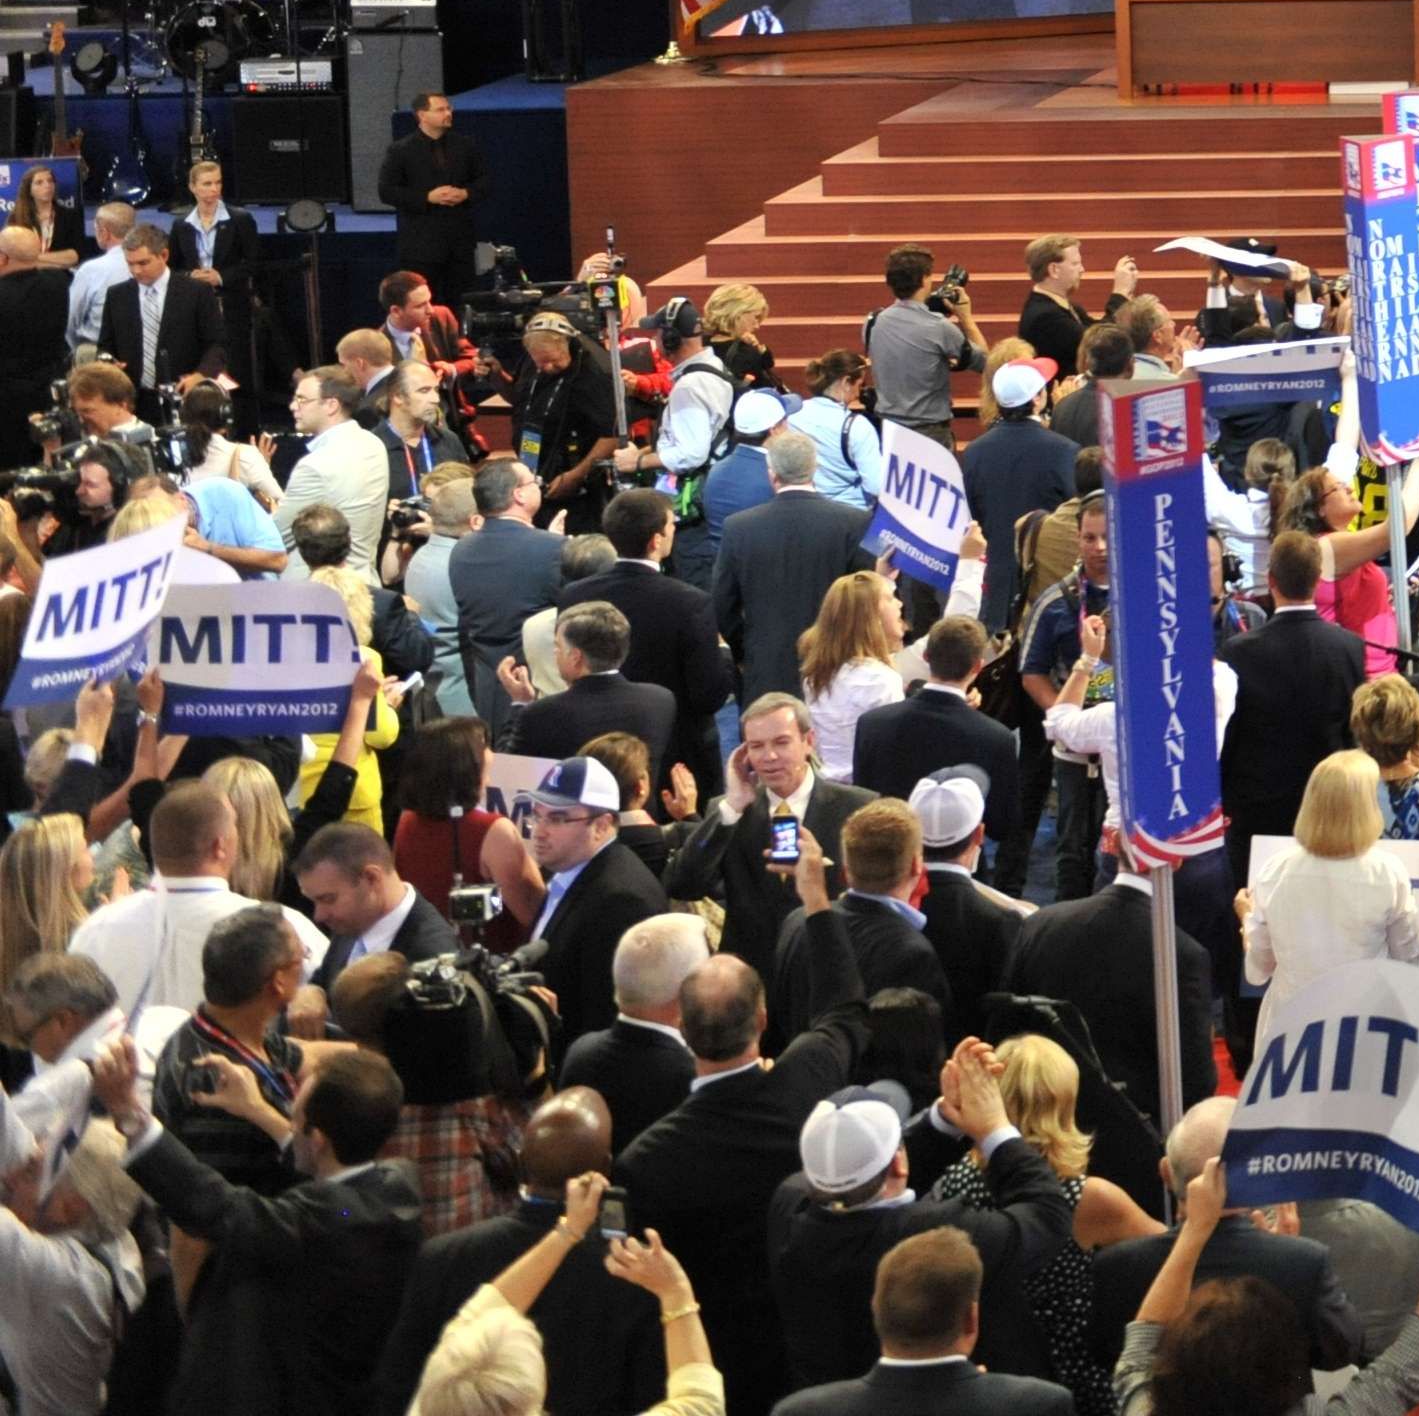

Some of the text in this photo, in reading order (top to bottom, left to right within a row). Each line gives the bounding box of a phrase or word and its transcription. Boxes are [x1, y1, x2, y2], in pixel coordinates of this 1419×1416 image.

[1369, 218, 1392, 384] NORTHERN
[1208, 379, 1326, 393] #ROMNEYRYAN2012
[885, 453, 970, 532] MITT
[35, 550, 174, 643] MITT!
[159, 614, 362, 665] MITT!
[1154, 493, 1190, 821] PENNSYLVANIA
[173, 703, 339, 718] #ROMNEYRYAN2012
